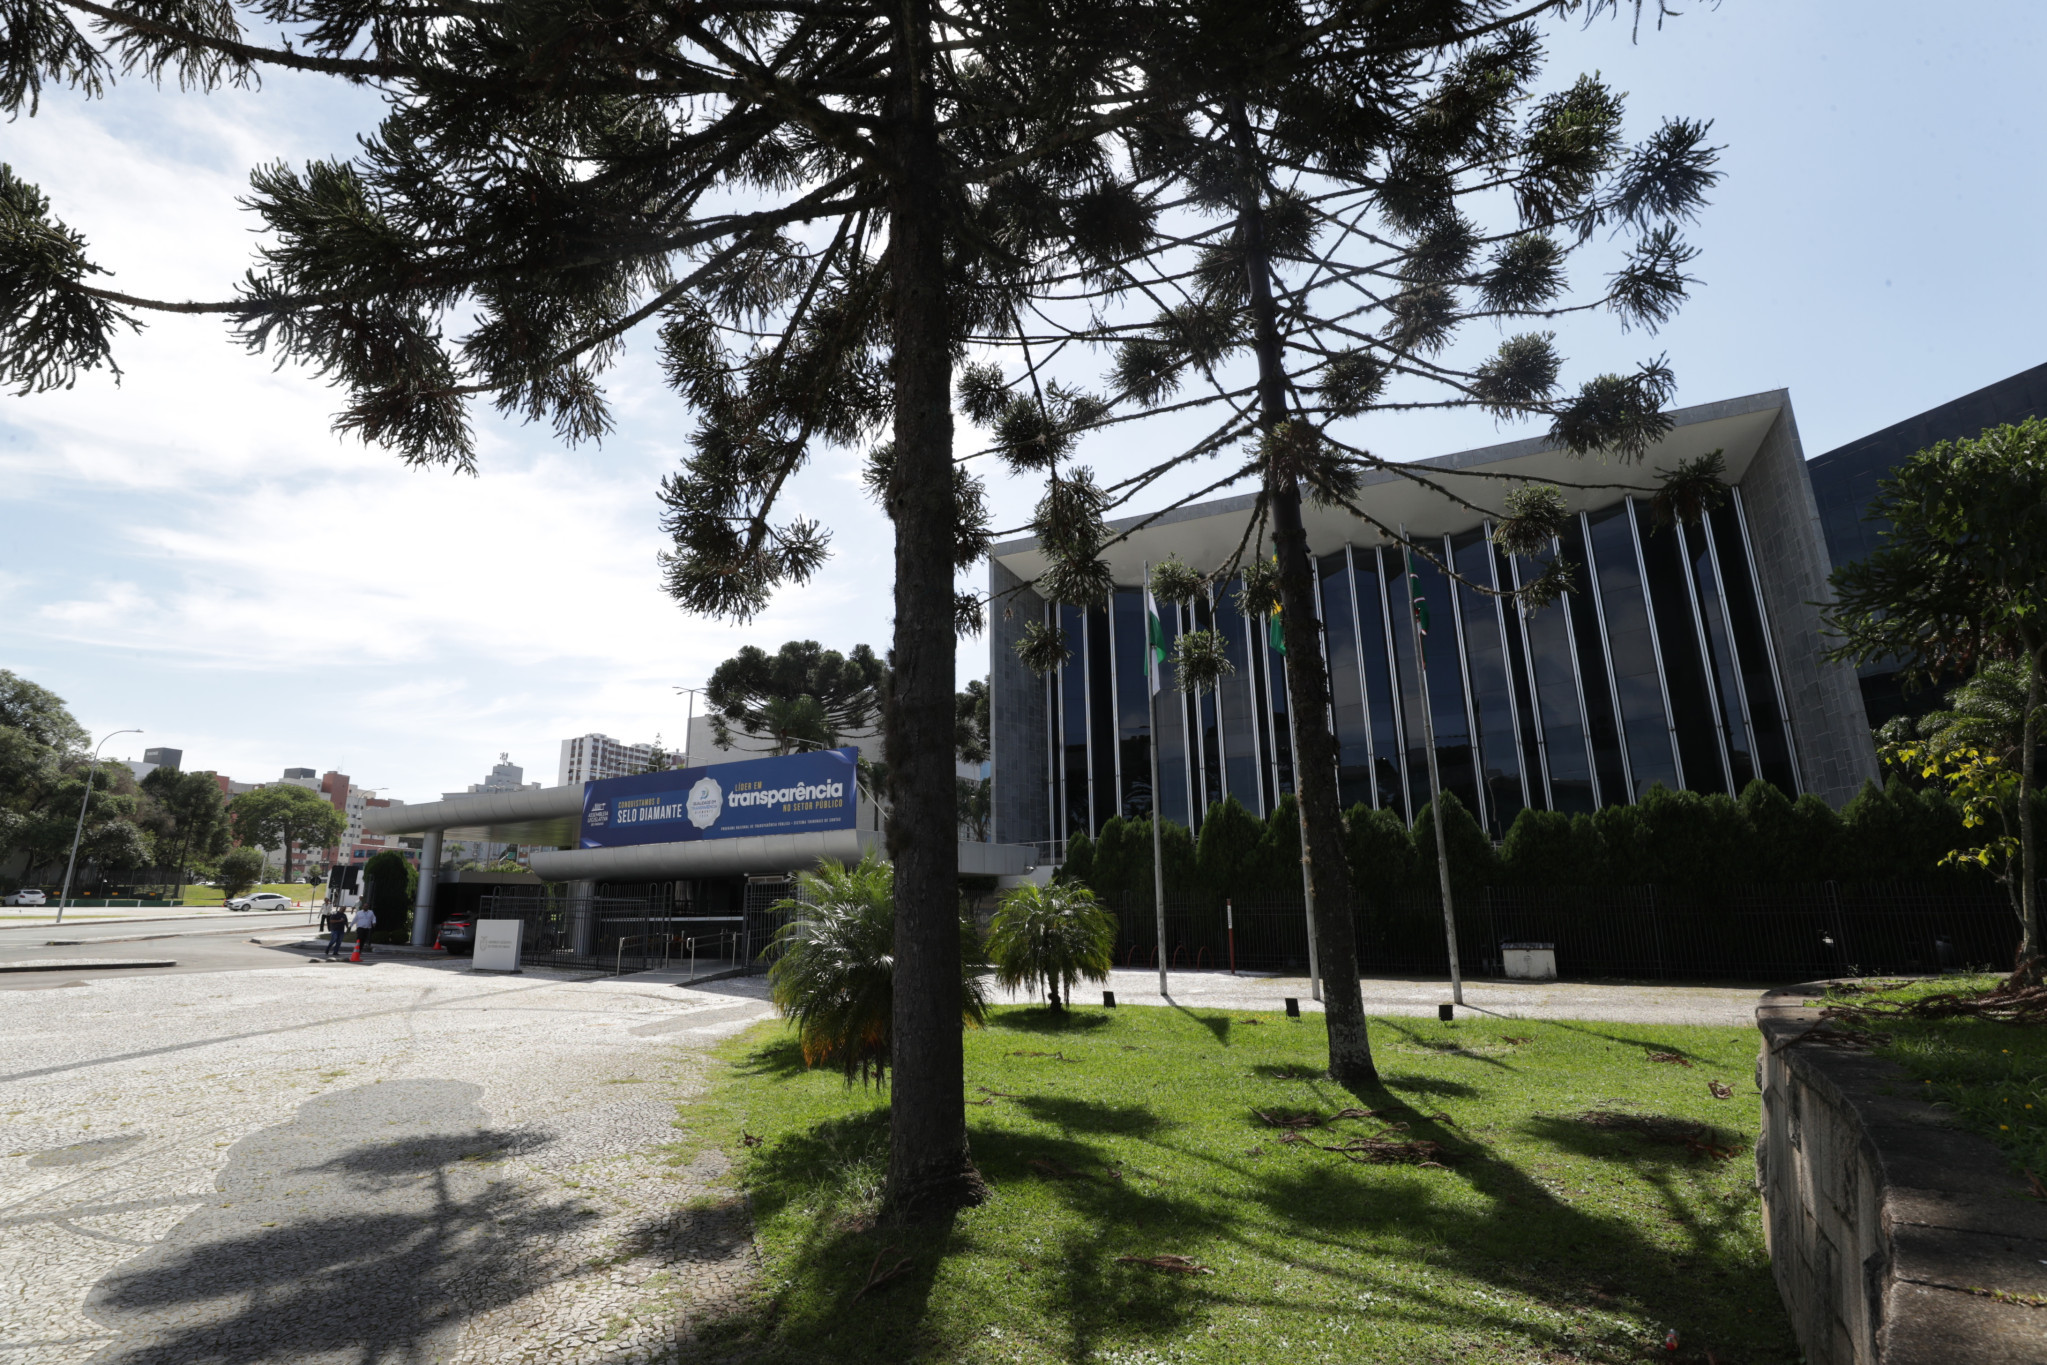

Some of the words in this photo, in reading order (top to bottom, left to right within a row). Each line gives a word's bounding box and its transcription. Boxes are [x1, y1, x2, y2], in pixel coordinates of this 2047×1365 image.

[728, 778, 843, 808] transparência
[735, 781, 752, 792] LÍDER
[754, 781, 763, 790] EM
[618, 798, 655, 809] CONQUISTAMOS
[782, 803, 792, 812] NO
[793, 801, 813, 811] SETOR
[815, 799, 843, 810] PÚBLICO
[617, 807, 637, 824] SELO
[640, 803, 683, 821] DIAMANTE
